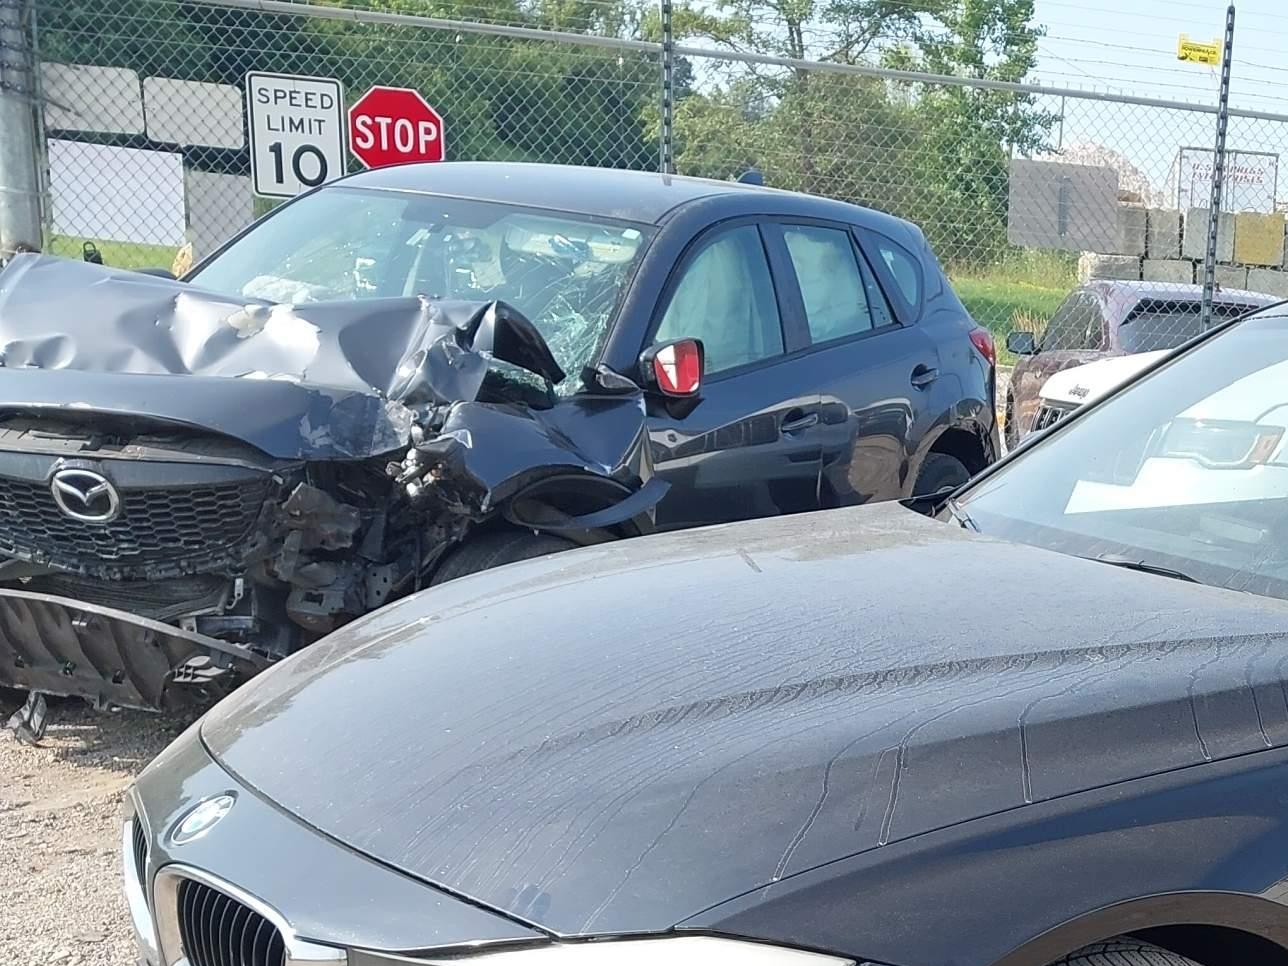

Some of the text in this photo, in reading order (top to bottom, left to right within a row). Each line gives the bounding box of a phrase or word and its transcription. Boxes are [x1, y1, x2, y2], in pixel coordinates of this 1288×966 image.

[257, 87, 334, 110] SPEED
[266, 114, 326, 136] LIMIT
[354, 114, 438, 155] STOP
[268, 141, 328, 187] 10
